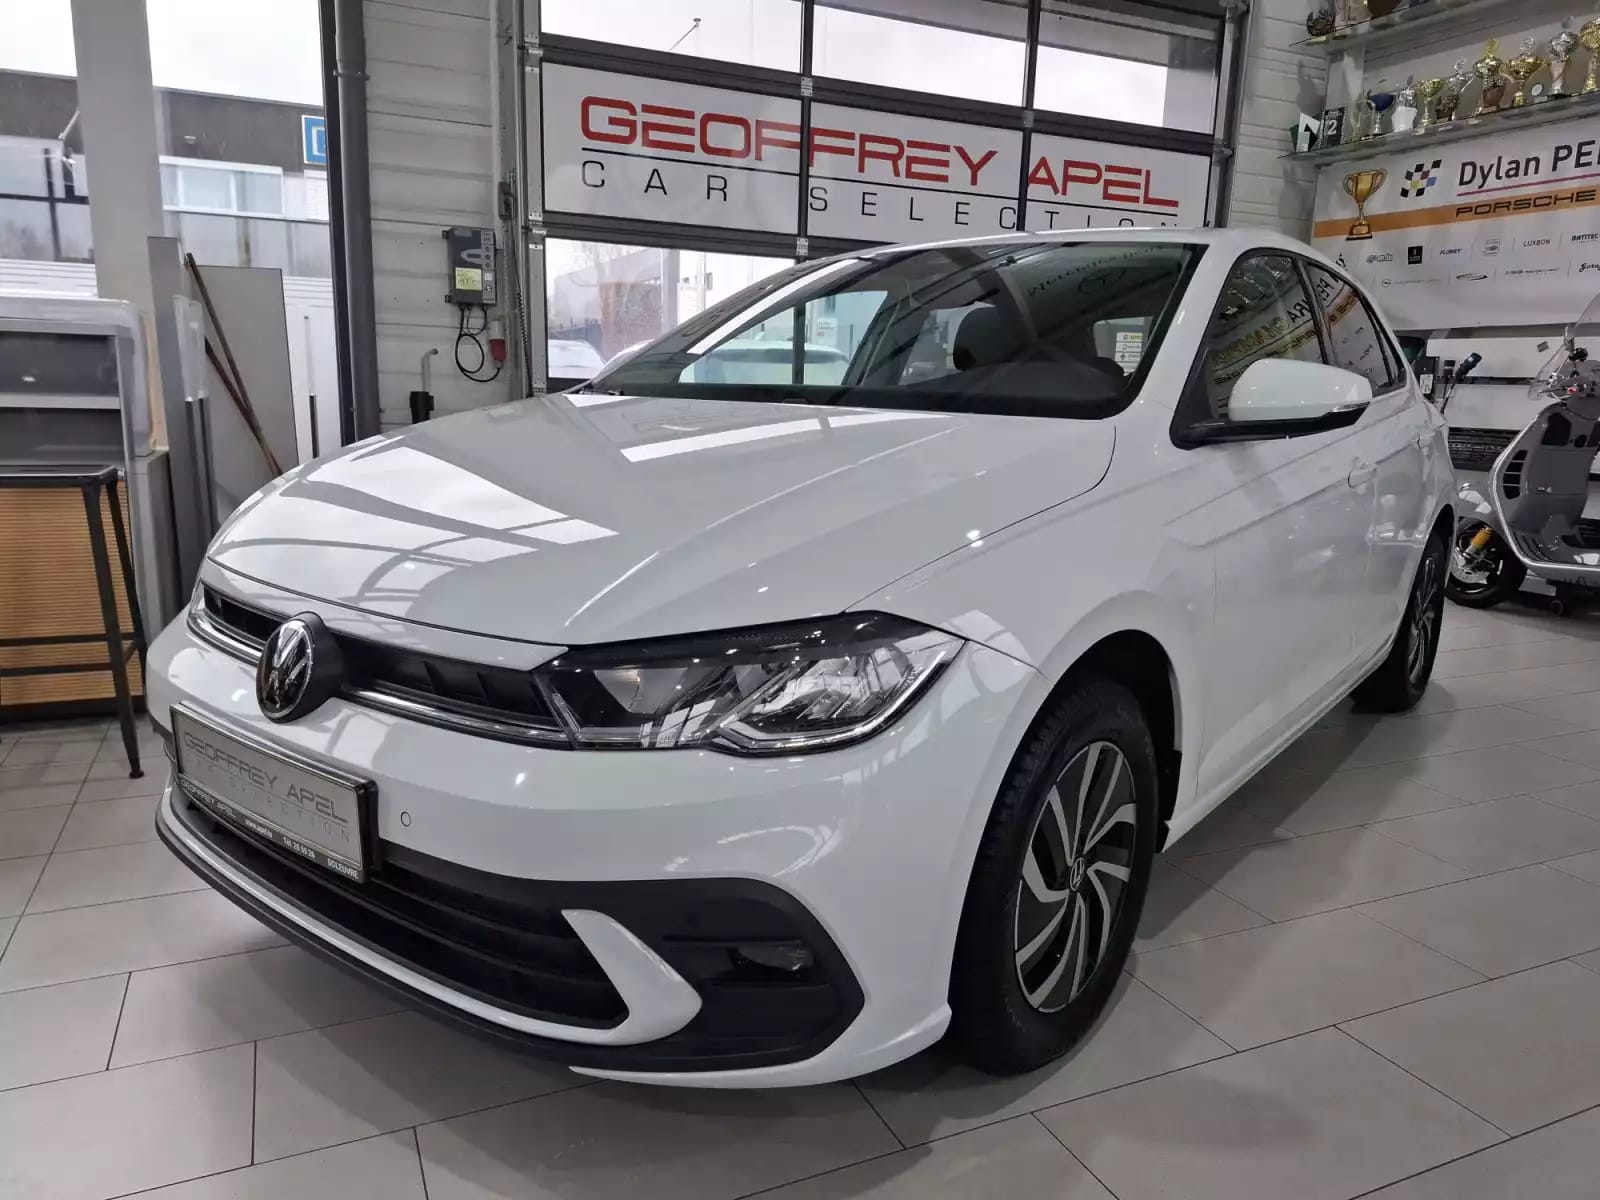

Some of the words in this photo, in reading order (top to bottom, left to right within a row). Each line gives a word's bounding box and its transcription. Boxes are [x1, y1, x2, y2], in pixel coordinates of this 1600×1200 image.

[581, 95, 998, 186] GEOFFREY
[1028, 155, 1179, 208] APEL
[1458, 155, 1540, 189] Dylan
[1552, 139, 1600, 172] PE
[581, 160, 727, 202] CAR
[1456, 190, 1597, 217] PORSCHE
[1523, 238, 1551, 248] LUXBON
[184, 731, 279, 791] GEOFFREY
[286, 783, 348, 824] APEL
[327, 858, 360, 880] SOLEUVRE
